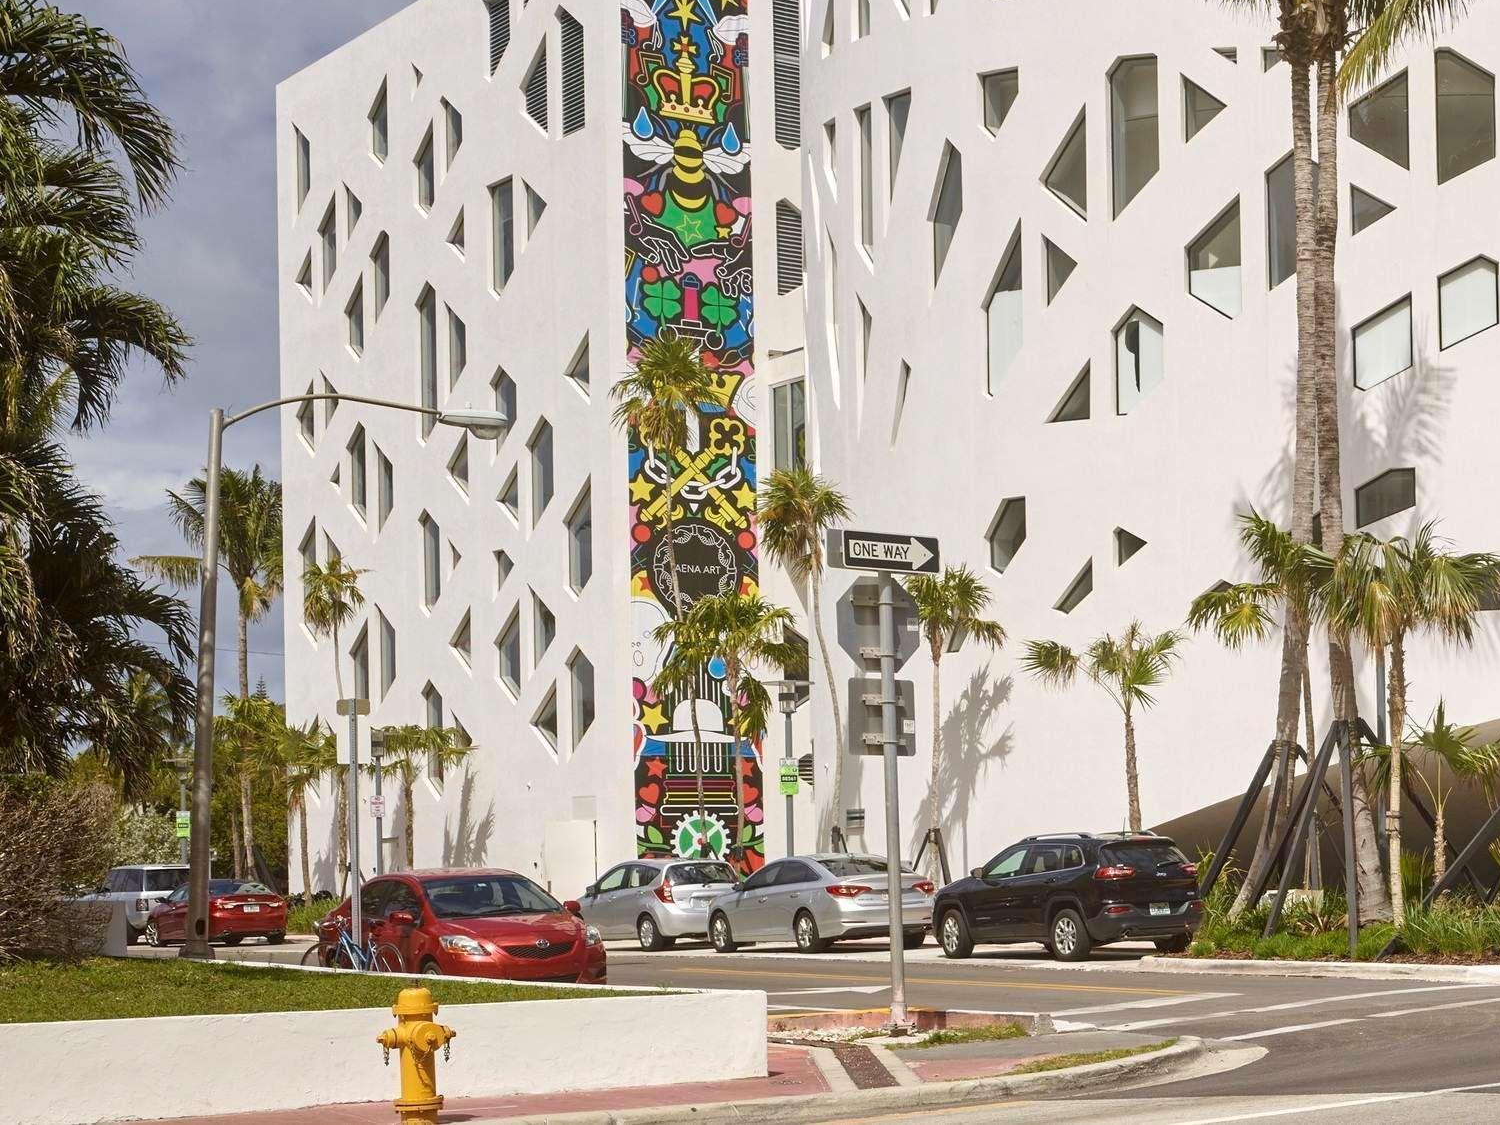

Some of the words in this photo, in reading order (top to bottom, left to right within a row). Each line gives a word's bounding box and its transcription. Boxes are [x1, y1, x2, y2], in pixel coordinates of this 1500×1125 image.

[853, 543, 878, 557] ONE
[883, 545, 909, 560] WAY
[703, 565, 720, 575] ART
